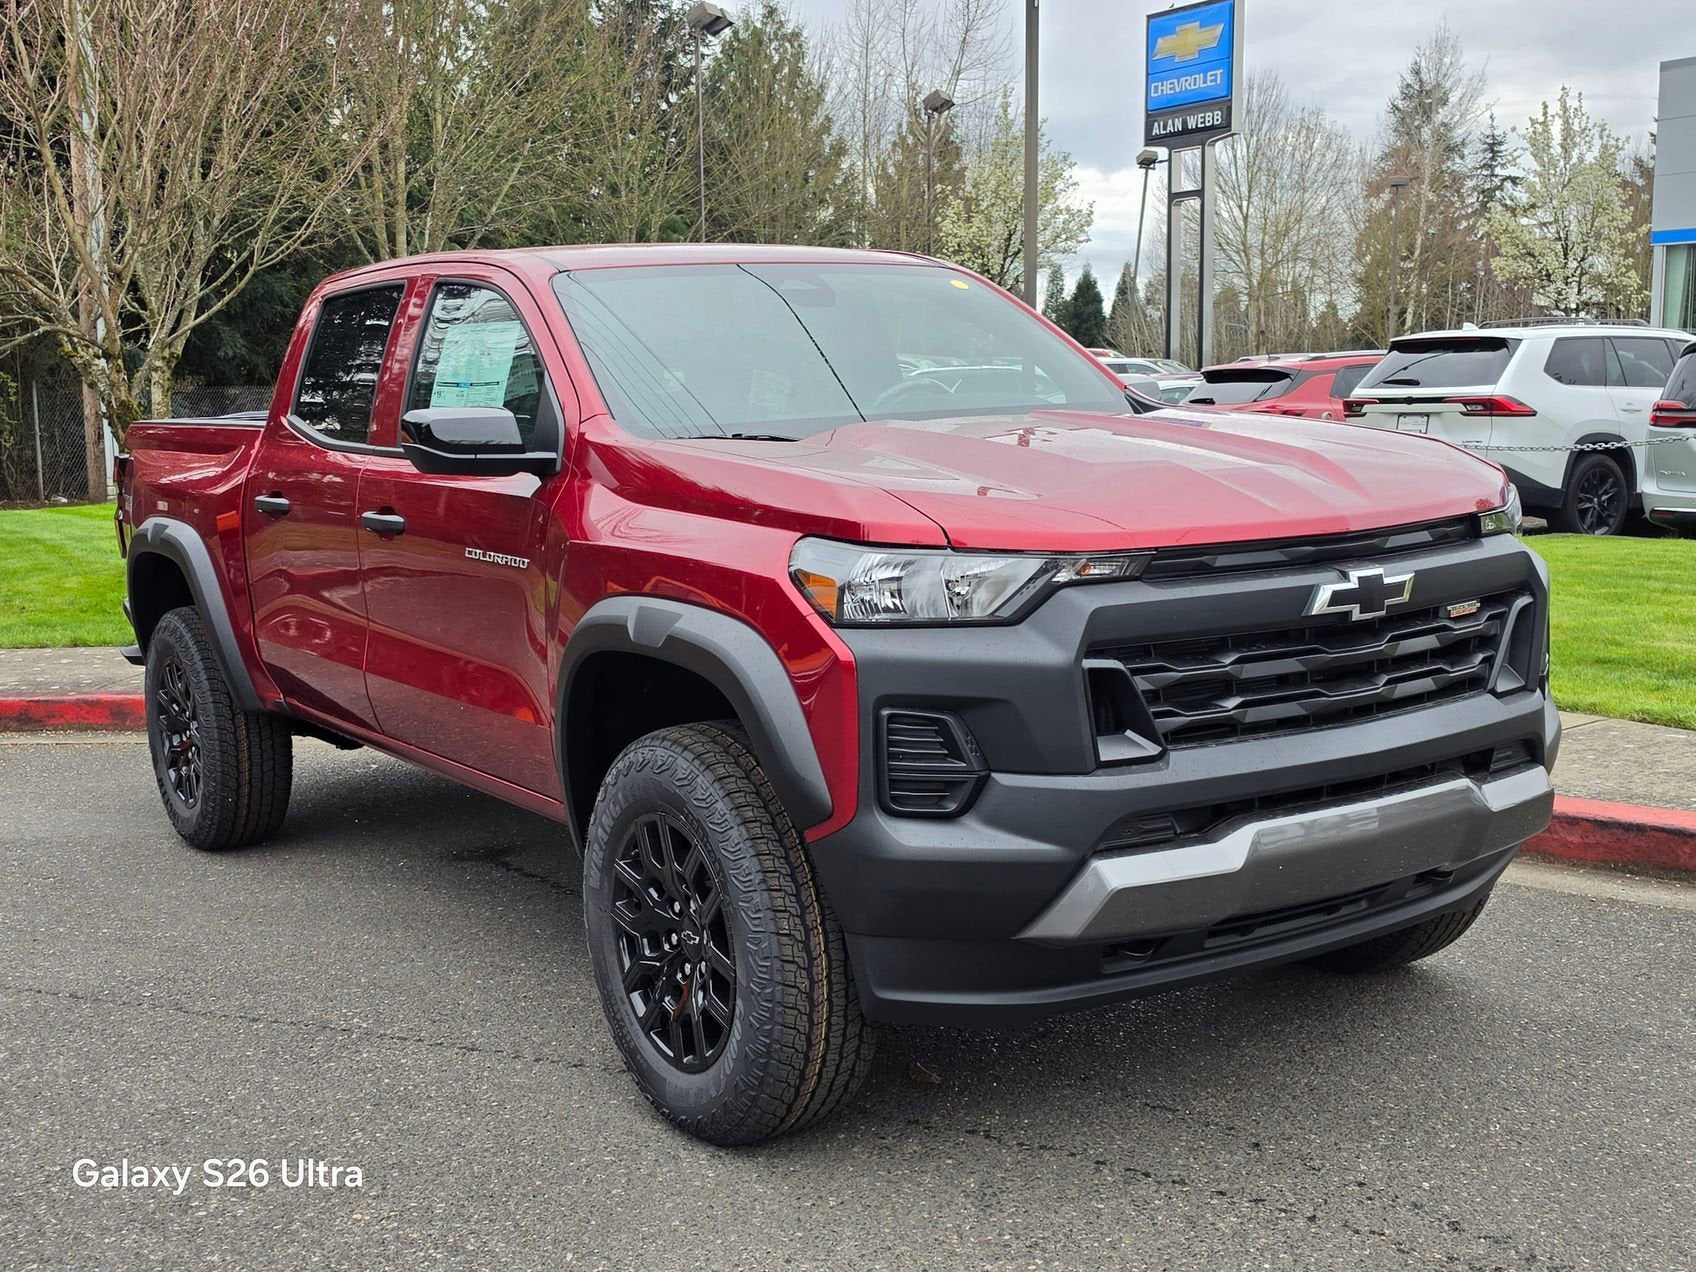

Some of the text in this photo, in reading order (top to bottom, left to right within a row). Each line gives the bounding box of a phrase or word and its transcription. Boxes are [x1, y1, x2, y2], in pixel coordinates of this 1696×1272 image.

[1151, 69, 1224, 97] CHEVROLET
[1152, 110, 1222, 136] ALAN WEBB
[464, 547, 530, 569] COLORADO
